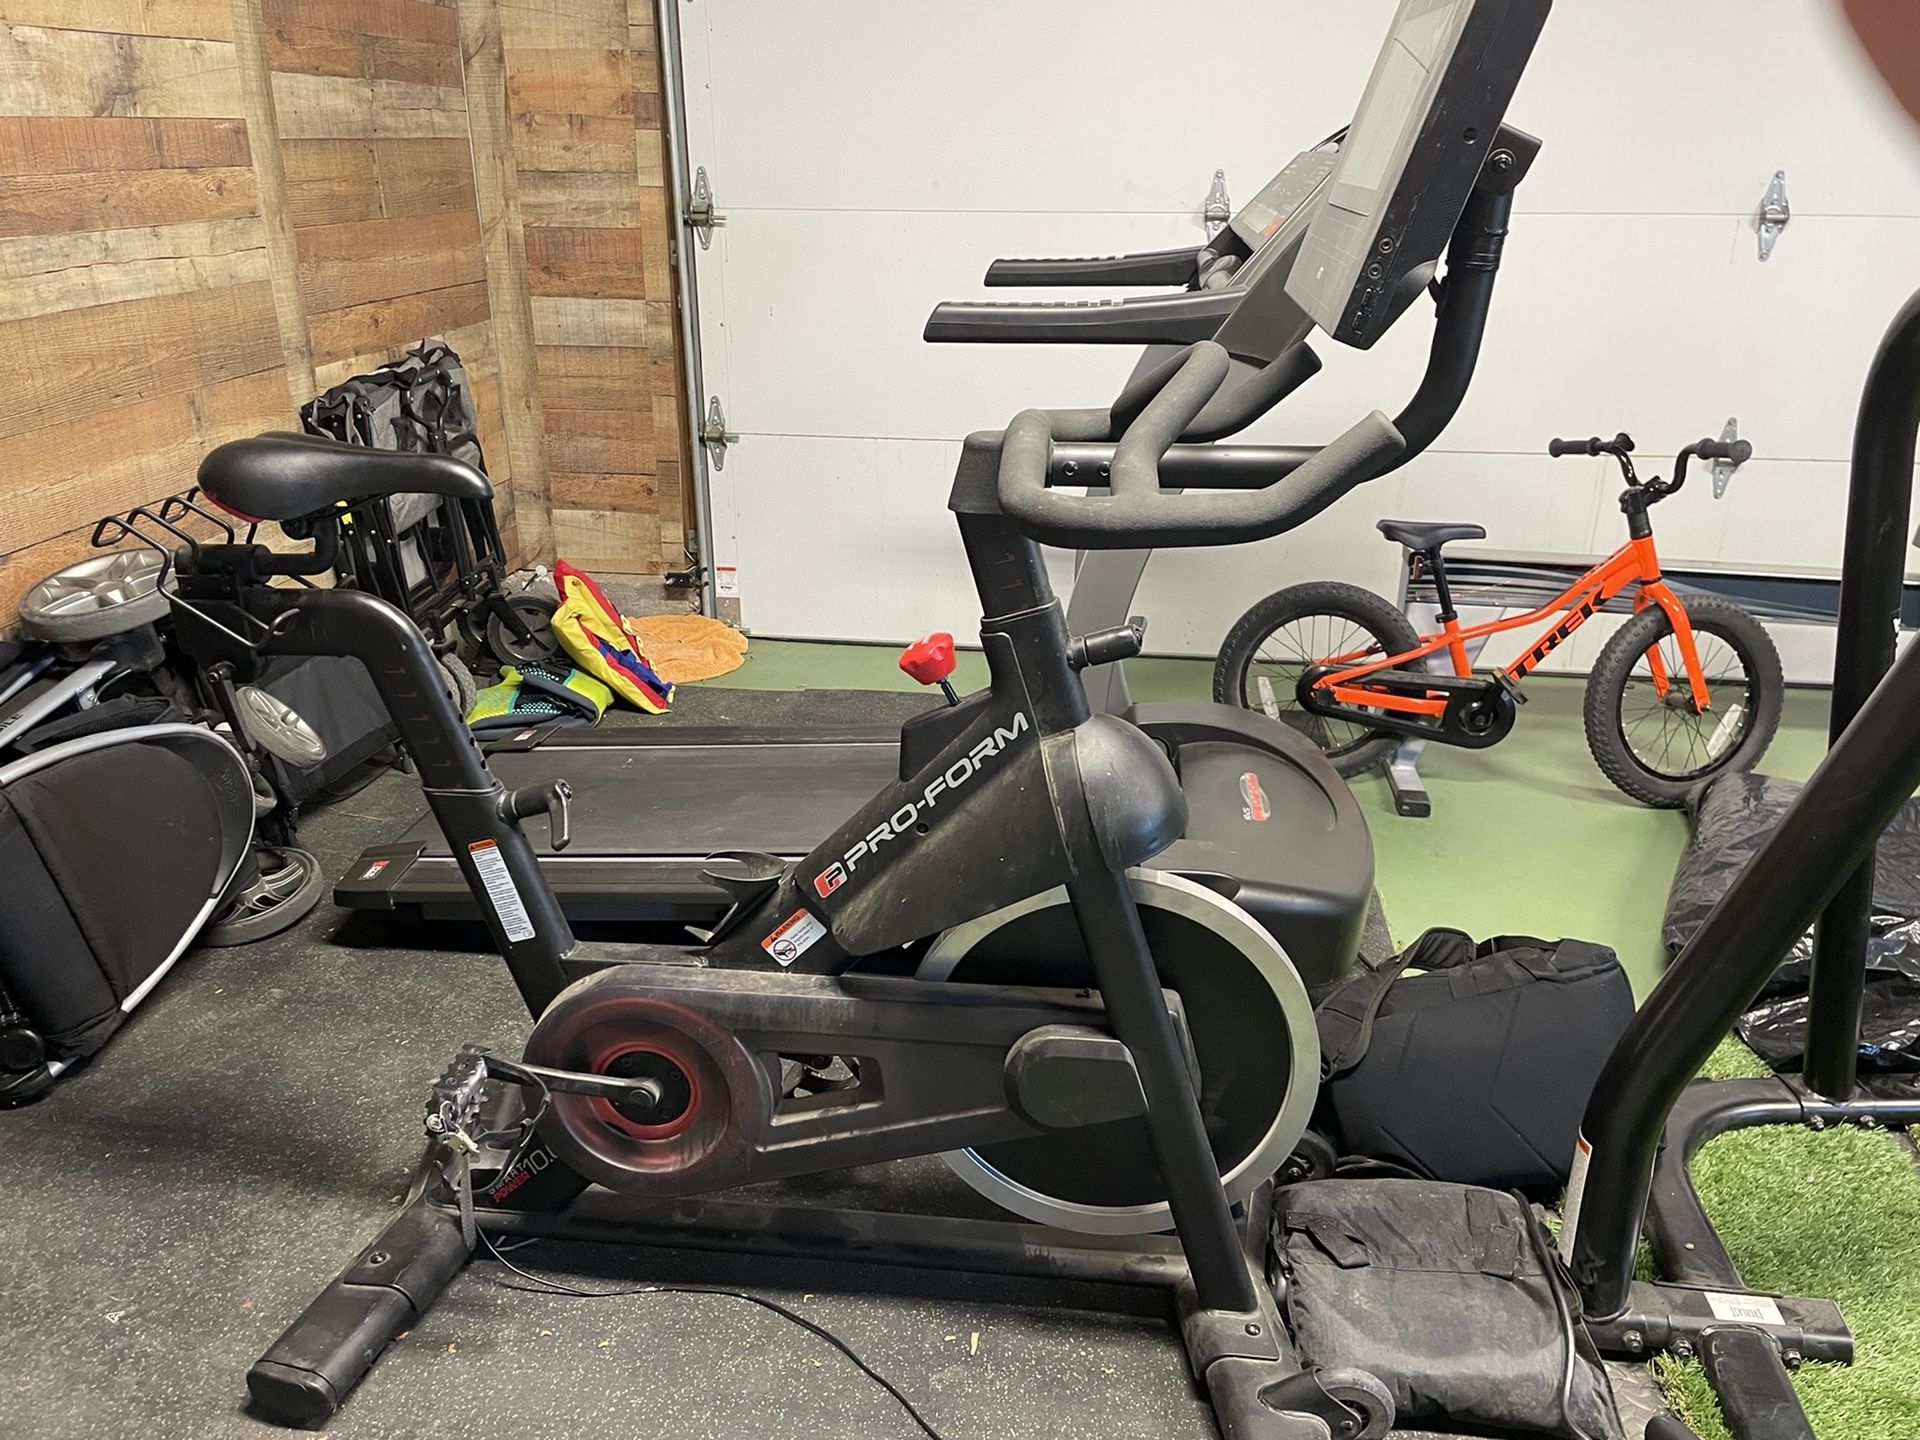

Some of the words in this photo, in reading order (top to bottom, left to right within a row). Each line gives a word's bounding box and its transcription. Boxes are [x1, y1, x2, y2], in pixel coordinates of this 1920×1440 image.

[1508, 586, 1611, 679] TREK
[844, 711, 1030, 872] PRO-FORM
[493, 1170, 531, 1203] POWER
